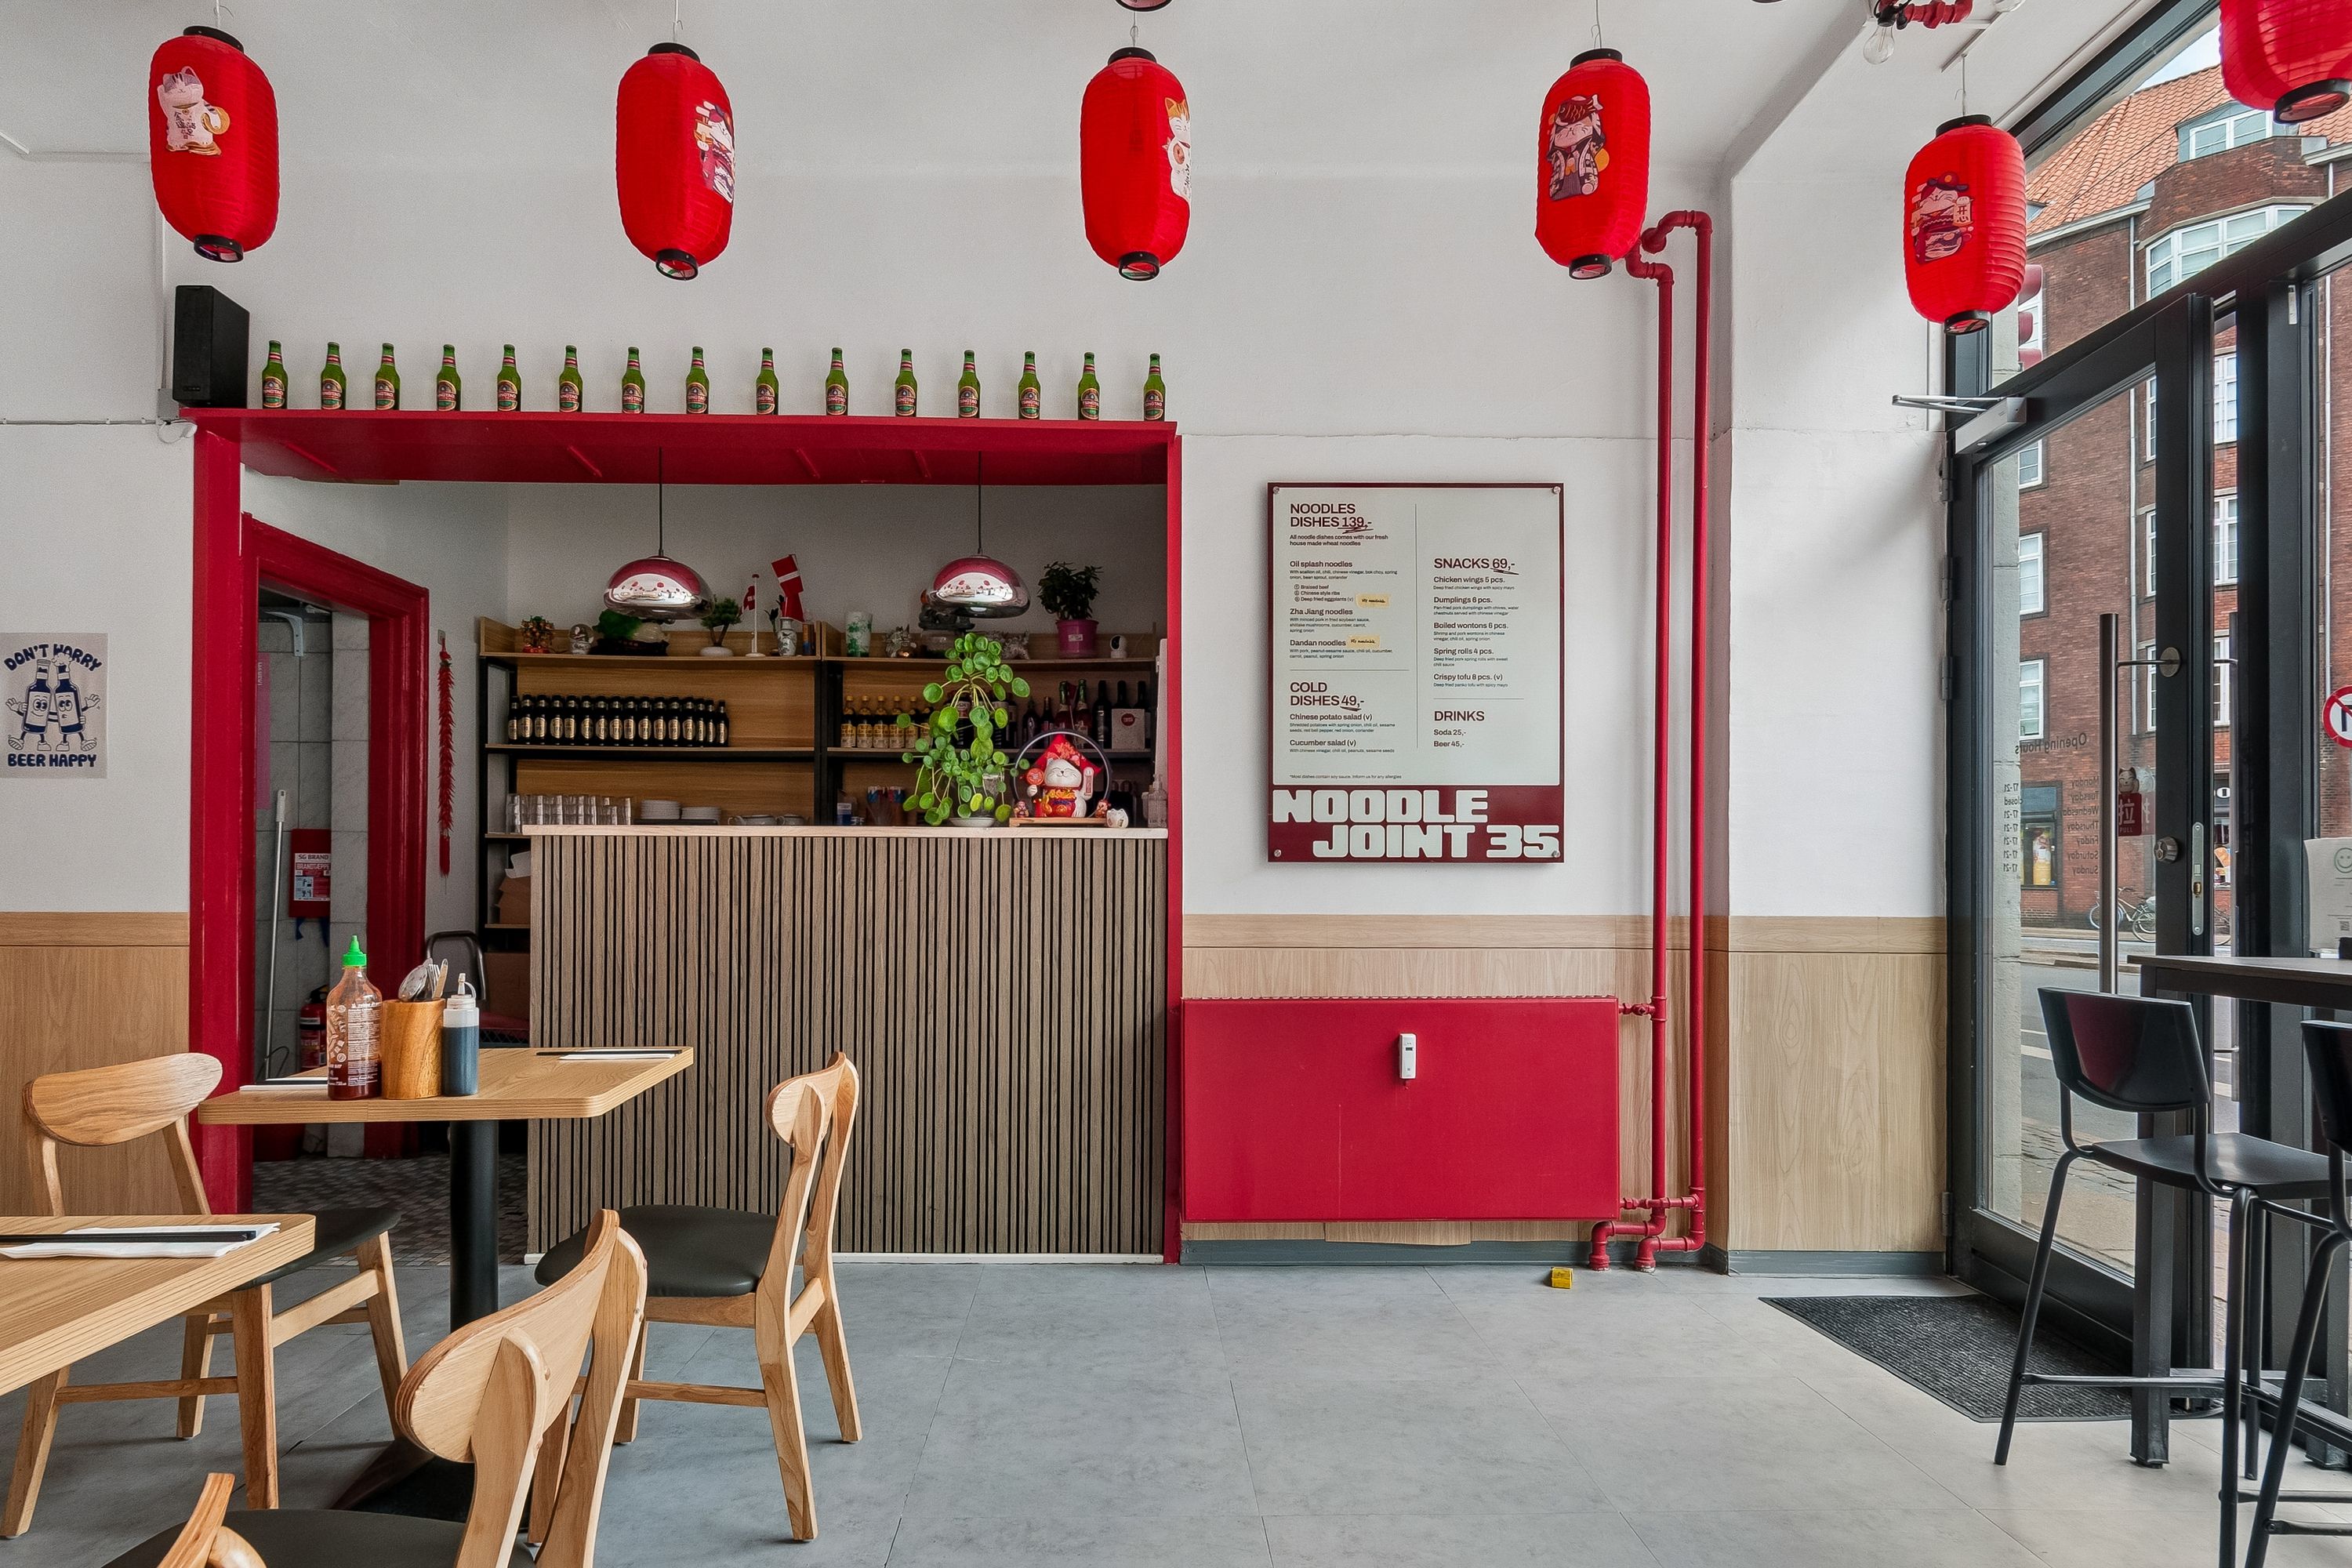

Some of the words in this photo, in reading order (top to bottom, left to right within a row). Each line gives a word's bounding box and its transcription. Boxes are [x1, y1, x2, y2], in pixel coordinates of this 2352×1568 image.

[1290, 503, 1356, 514] NOODLES
[1290, 516, 1340, 528] DISHES
[1301, 561, 1324, 569] splash
[1434, 558, 1490, 569] SNACKS
[1434, 648, 1457, 656] Spring
[5, 644, 49, 671] DON'T
[53, 644, 102, 672] WORRY
[1290, 682, 1327, 693] COLD
[1290, 695, 1340, 706] DISHES
[1435, 710, 1485, 721] DRINKS
[8, 753, 45, 767] BEER
[49, 753, 97, 767] HAPPY
[1272, 789, 1488, 823] NOODLE
[2119, 798, 2135, 825] 拉
[1312, 825, 1475, 858] JOINT
[1486, 825, 1560, 858] 35
